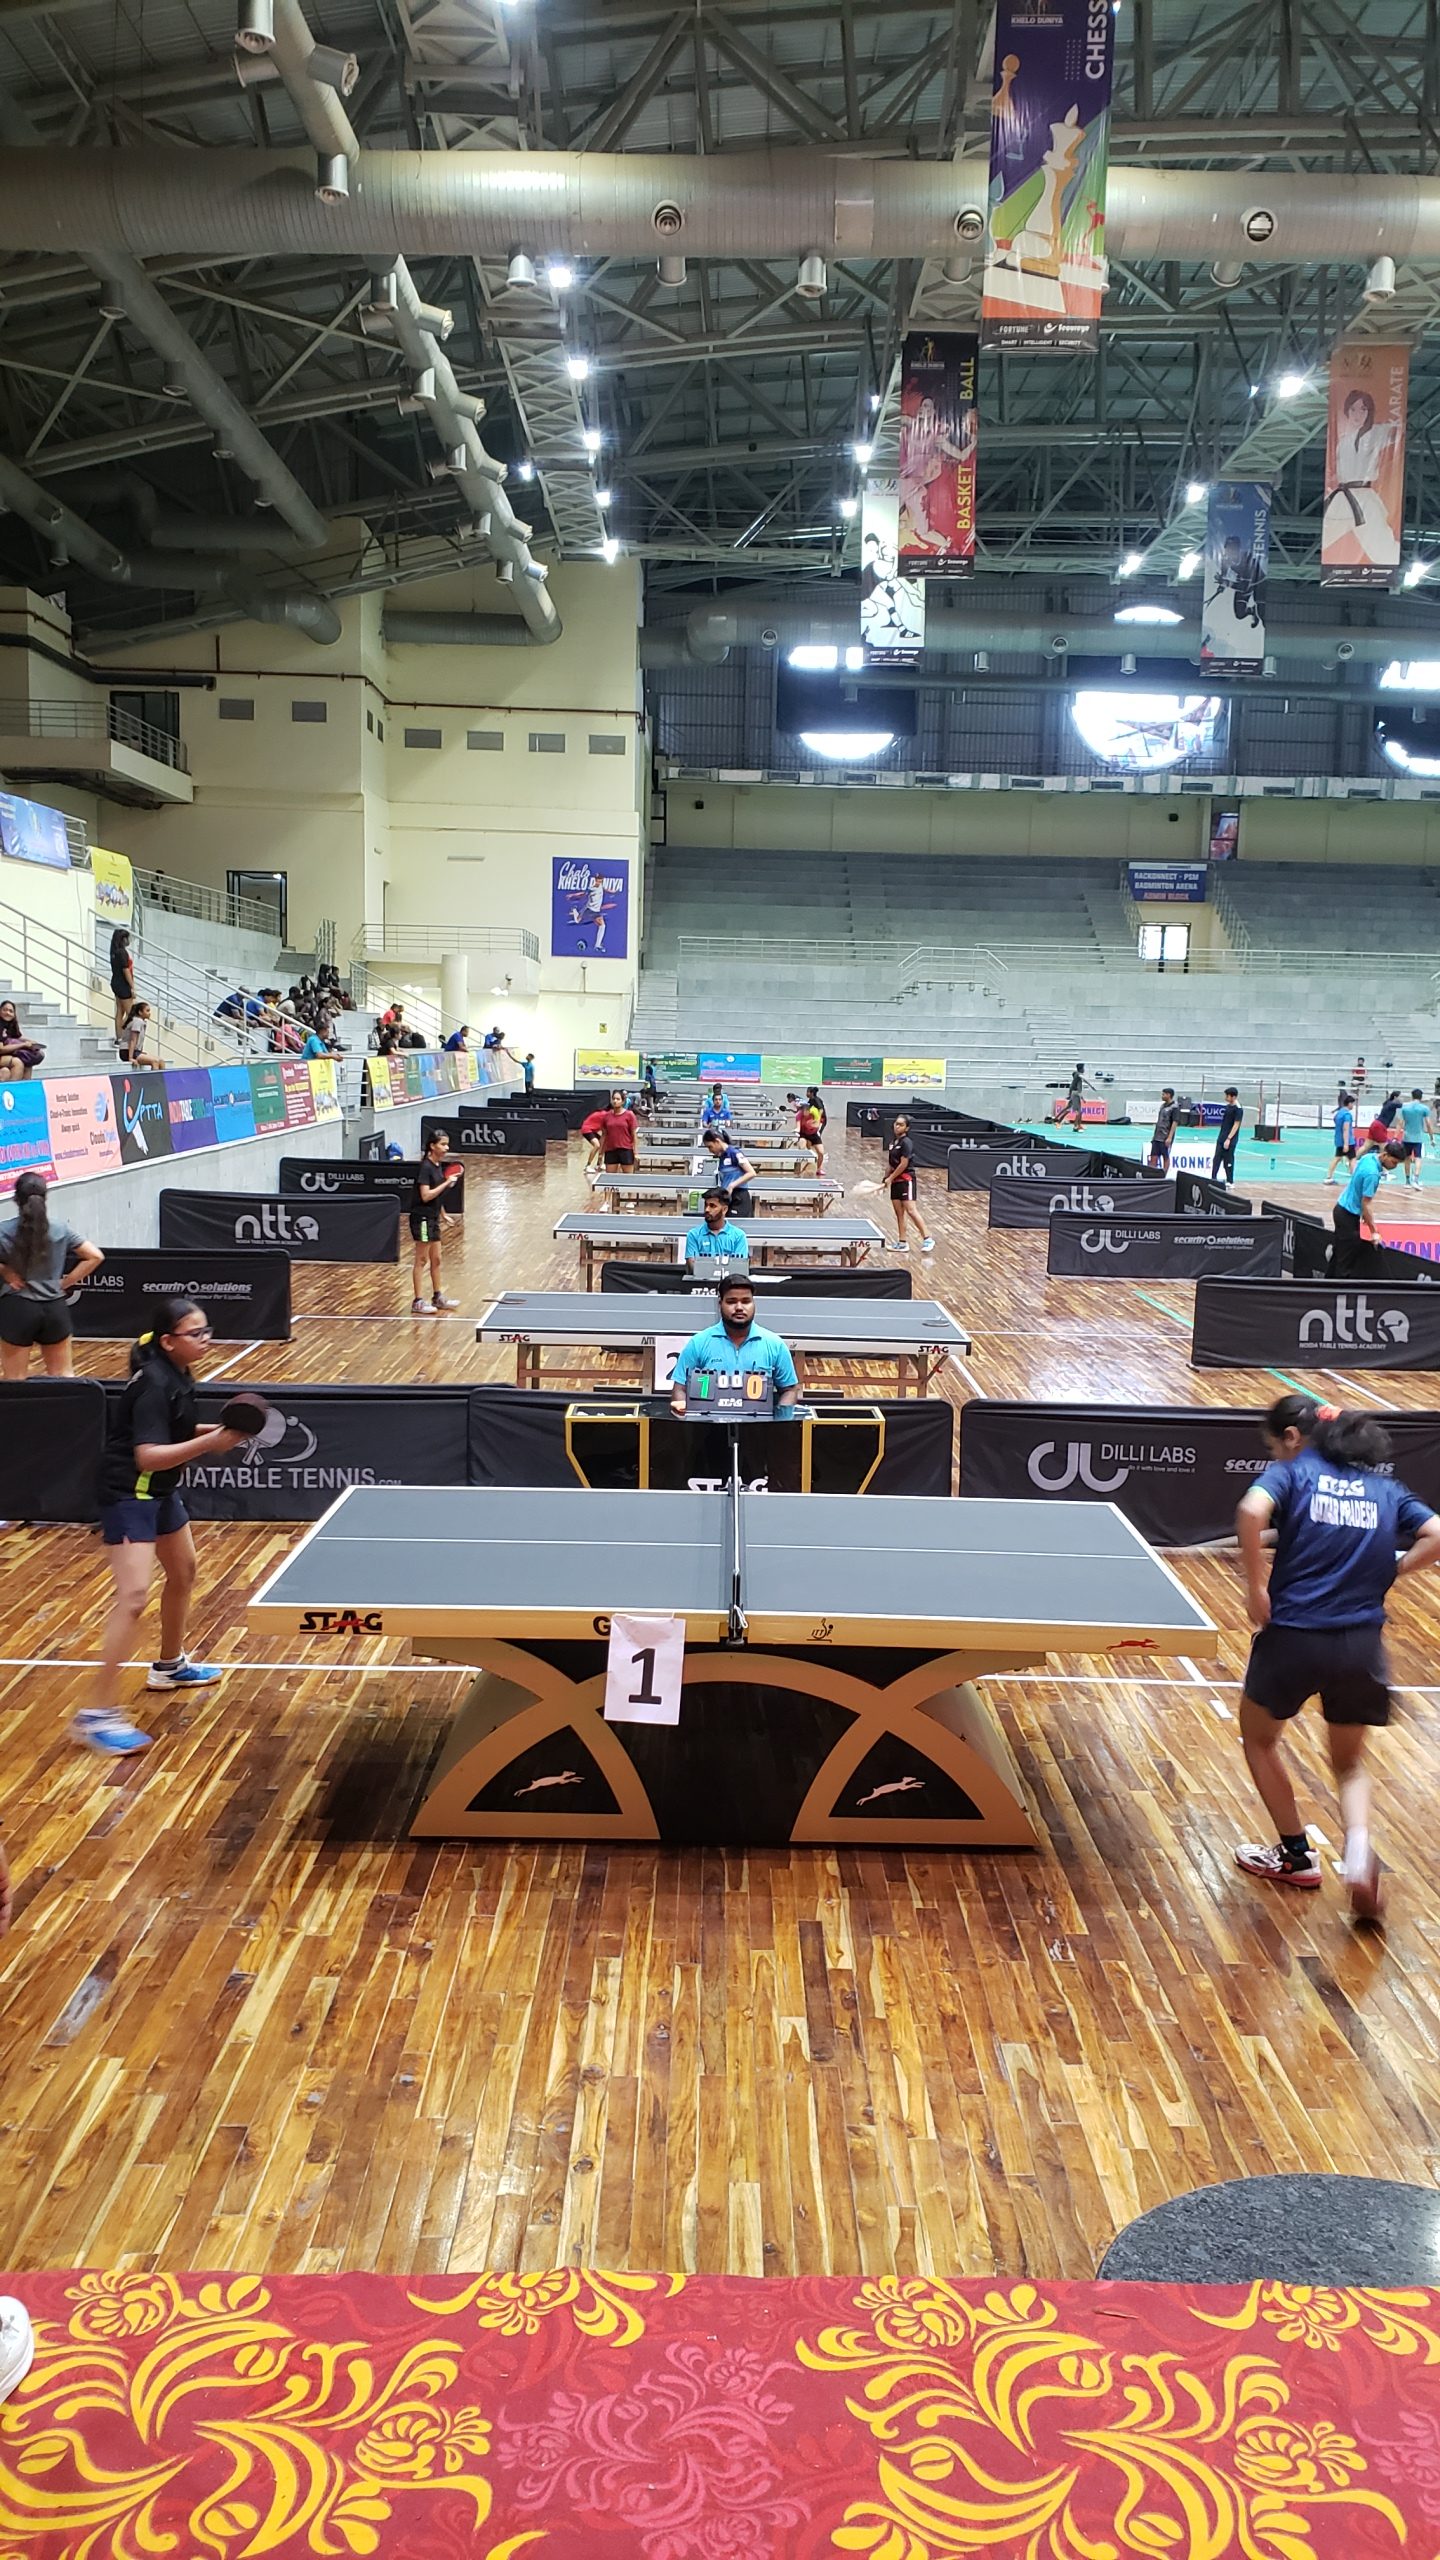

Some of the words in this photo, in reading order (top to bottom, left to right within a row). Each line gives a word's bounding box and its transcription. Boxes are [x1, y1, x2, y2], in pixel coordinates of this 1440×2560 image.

[1085, 0, 1108, 79] CHESS
[960, 357, 974, 400] BALL
[1388, 367, 1404, 427] KARATE
[957, 465, 972, 529] BASKET
[1253, 509, 1267, 558] TENNIS
[558, 876, 588, 890] KHELO
[589, 877, 623, 892] DNIYA
[328, 1173, 345, 1181] DILLI
[346, 1173, 365, 1182] LABS
[1115, 1229, 1137, 1239] DILLI
[1138, 1230, 1161, 1240] LABS
[94, 1275, 124, 1287] LABS
[142, 1282, 187, 1293] security
[200, 1282, 253, 1293] solutions
[499, 1334, 530, 1343] STAG
[1338, 1342, 1358, 1350] TENNIS
[918, 1345, 949, 1354] STAG
[666, 1352, 681, 1381] 2
[698, 1375, 710, 1399] 1
[747, 1375, 763, 1400] 0
[1101, 1443, 1144, 1462] DILLI
[1150, 1446, 1196, 1464] LABS
[1224, 1458, 1279, 1473] secur
[288, 1467, 375, 1488] TENNIS
[1339, 1499, 1378, 1530] PRADESH
[300, 1611, 383, 1634] STAG
[629, 1648, 662, 1705] 1
